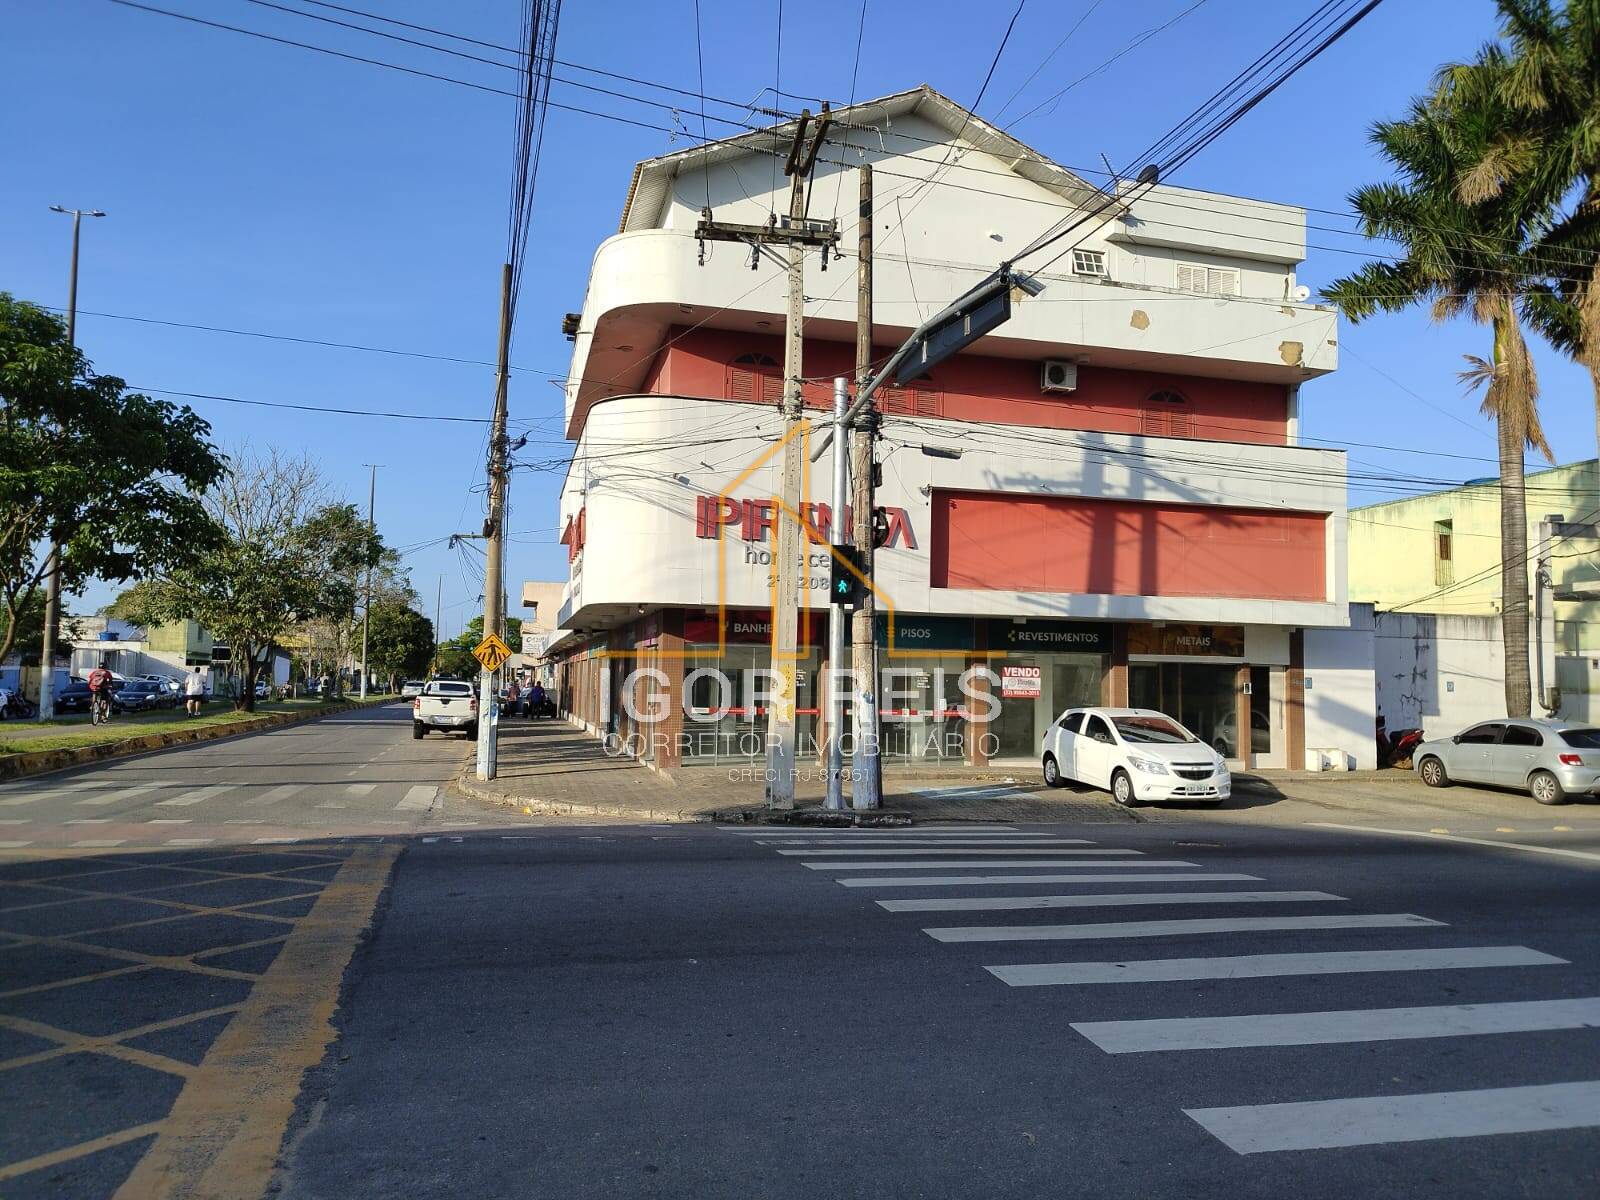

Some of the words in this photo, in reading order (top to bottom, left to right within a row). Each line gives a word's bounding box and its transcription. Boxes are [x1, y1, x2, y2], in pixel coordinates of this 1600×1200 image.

[696, 495, 919, 550] IPIRANA
[733, 622, 774, 633] BANHE
[901, 628, 931, 638] PISOS
[1018, 631, 1099, 643] REVESTIMENTOS
[1176, 636, 1211, 647] METAIS
[1003, 666, 1040, 677] VENDO
